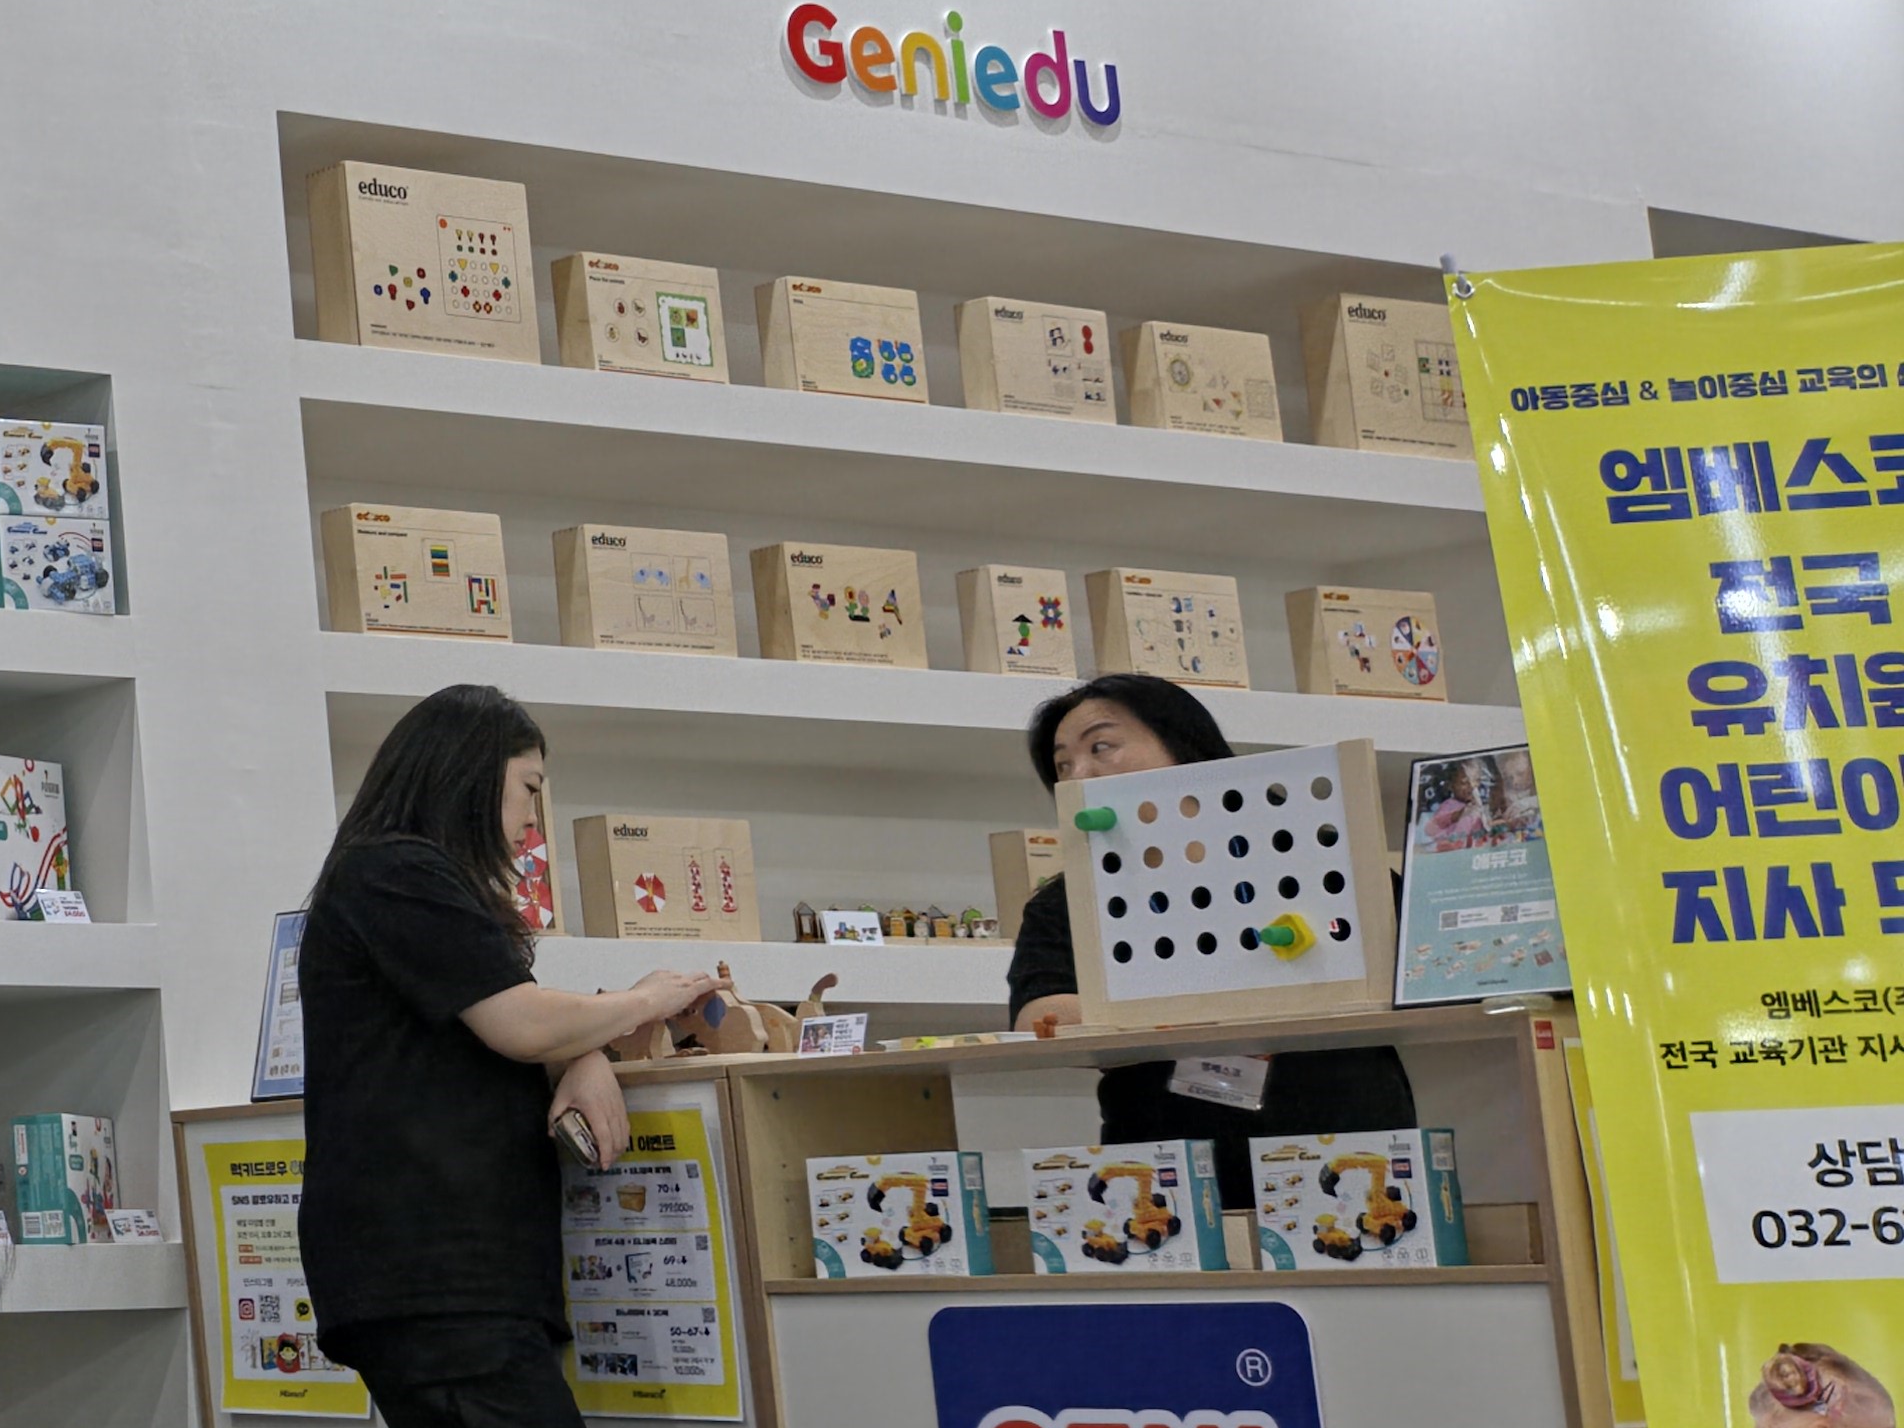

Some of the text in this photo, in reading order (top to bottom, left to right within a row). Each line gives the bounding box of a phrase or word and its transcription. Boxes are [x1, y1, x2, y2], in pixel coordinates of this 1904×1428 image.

[786, 3, 1121, 126] Geniedu
[358, 178, 408, 200] educo
[1347, 303, 1387, 321] educo
[1510, 380, 1630, 411] 아동중심
[1639, 380, 1660, 401] &
[1667, 369, 1789, 402] 놀이중심
[1796, 363, 1888, 393] 교육의
[591, 533, 626, 547] educo
[791, 551, 824, 564] educo
[1709, 552, 1892, 634] 전국
[613, 824, 648, 837] educo
[1661, 862, 1846, 943] 지사
[1660, 1040, 1719, 1070] 전국
[1729, 1035, 1848, 1067] 교육기관
[638, 1134, 676, 1152] 이벤트
[230, 1161, 288, 1177] 럭키드로우
[1751, 1206, 1904, 1250] 032-6
